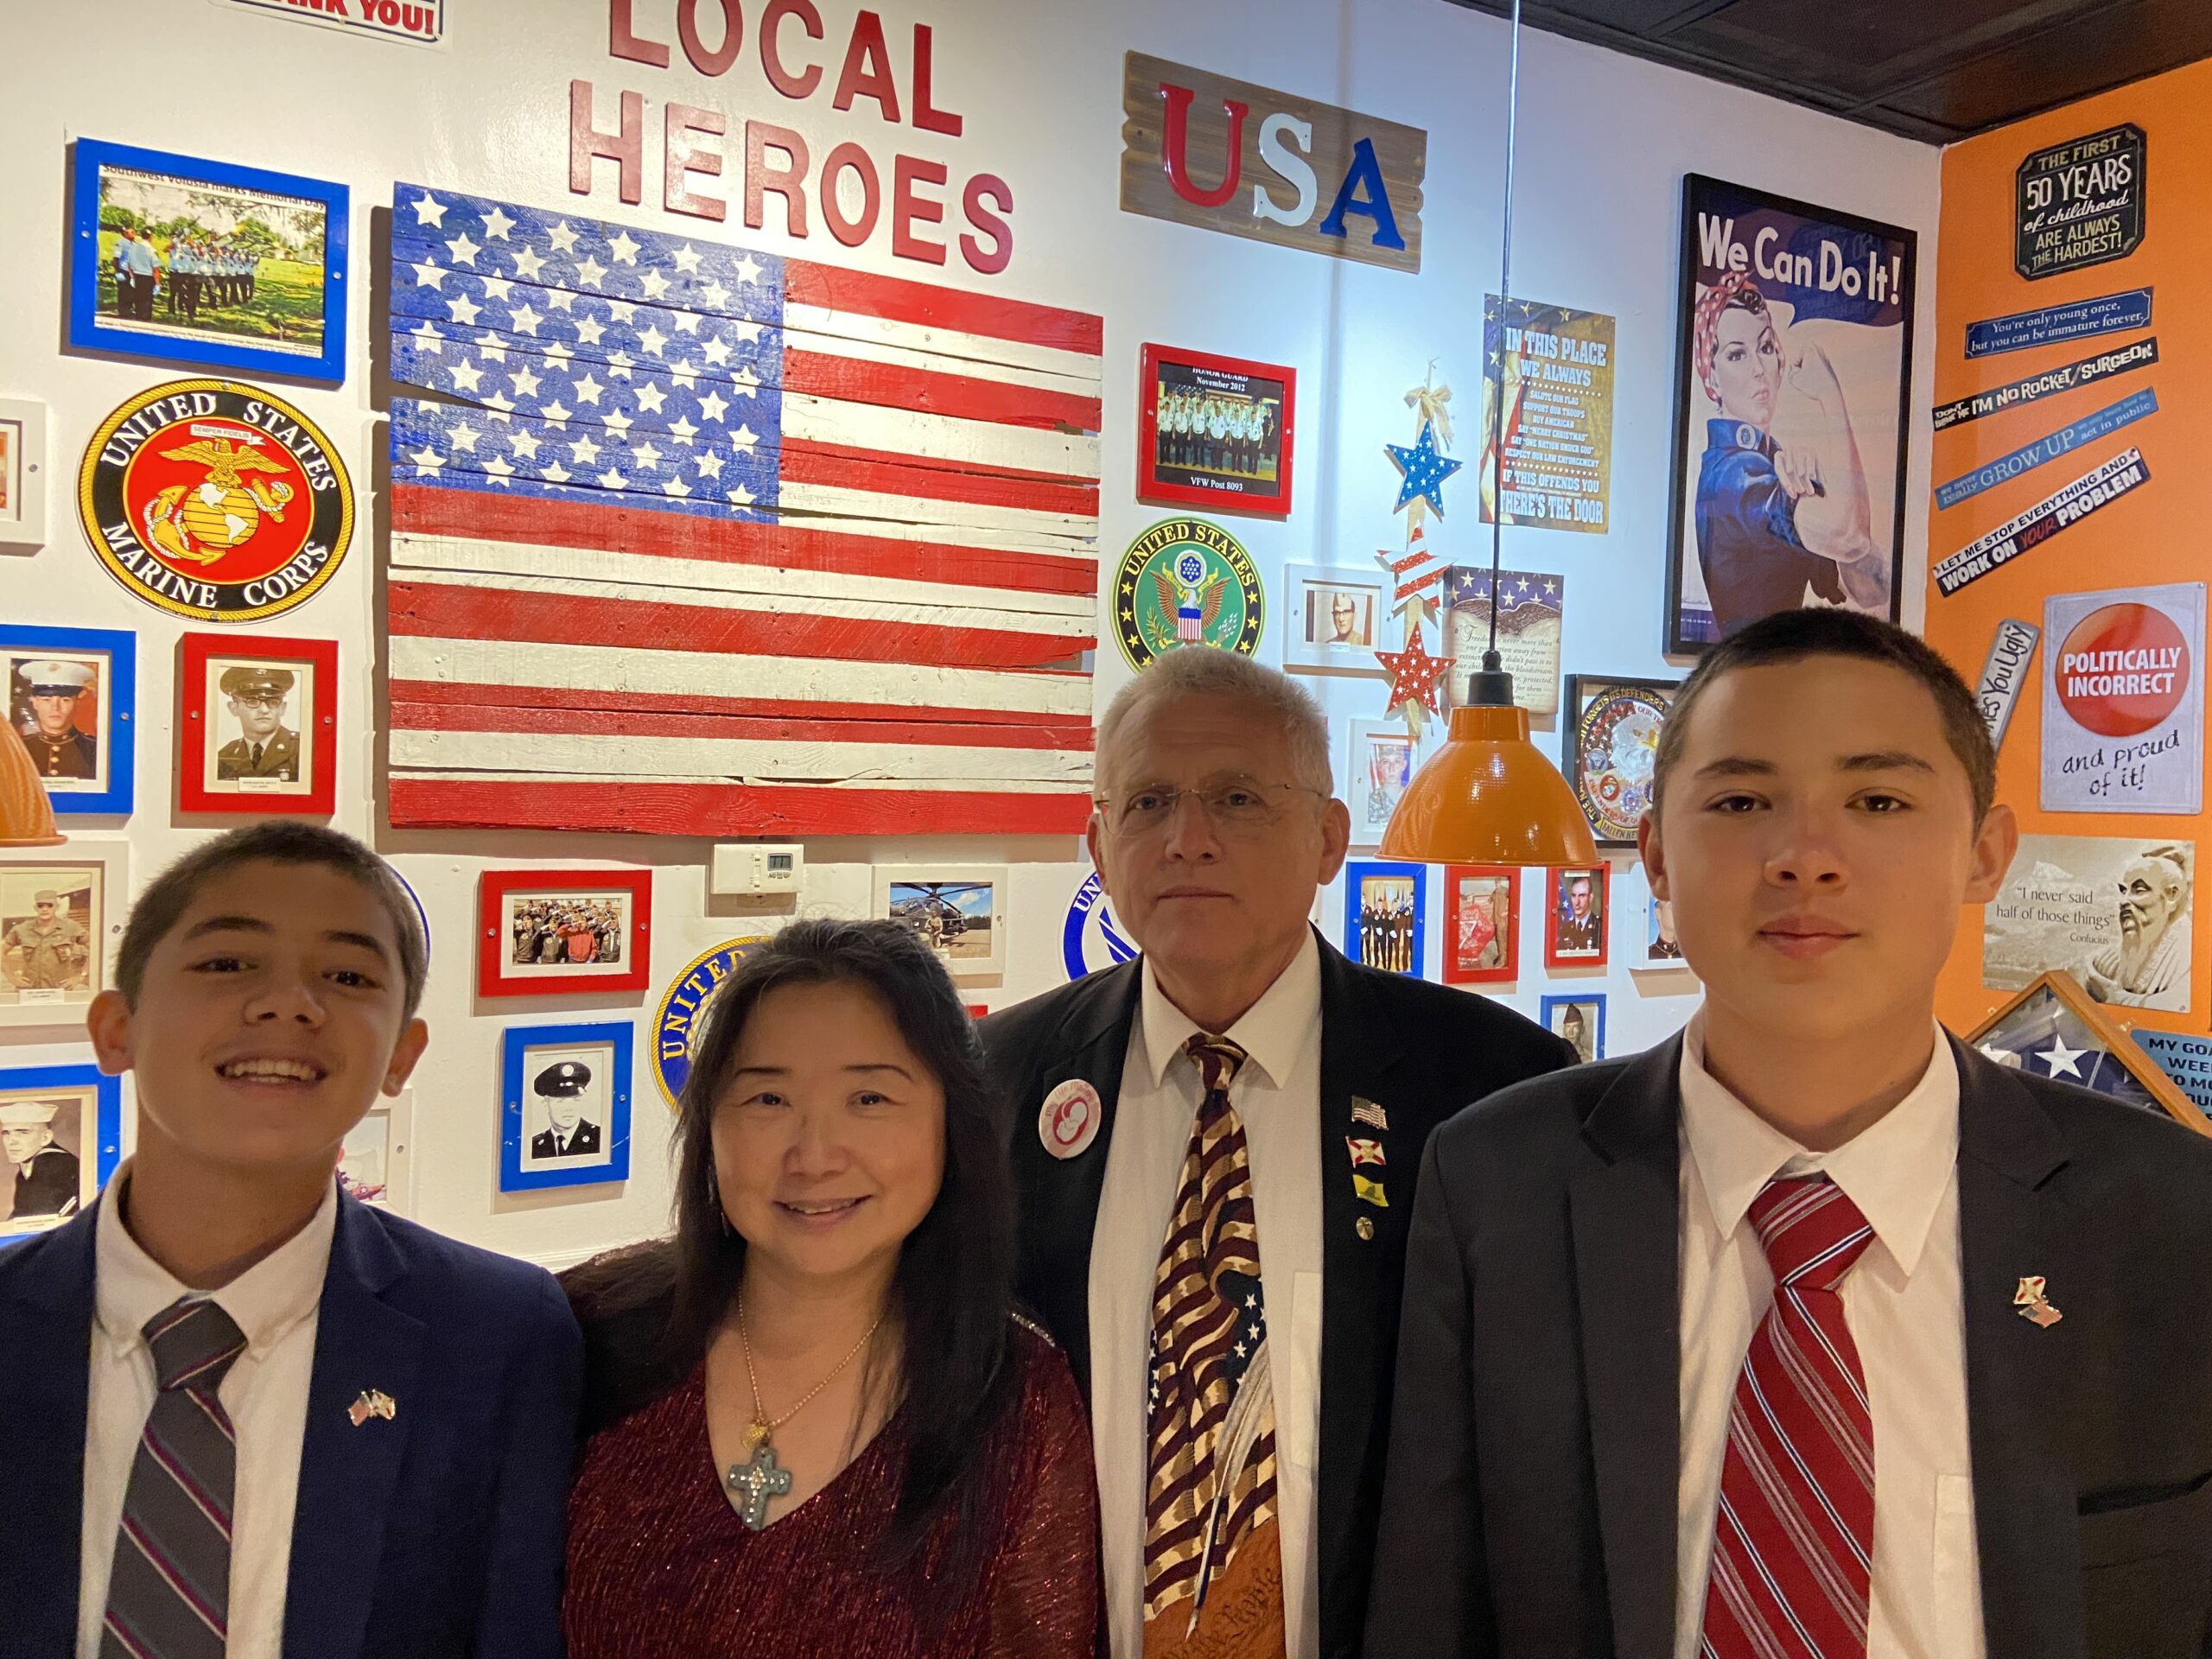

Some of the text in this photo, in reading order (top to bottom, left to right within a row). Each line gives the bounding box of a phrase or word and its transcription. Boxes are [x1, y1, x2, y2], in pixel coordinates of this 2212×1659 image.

[360, 0, 435, 35] YOU!
[609, 0, 963, 137] LOCAL
[1159, 82, 1405, 251] USA
[2038, 136, 2120, 170] THE FIRST
[569, 79, 1014, 275] HEROES
[2027, 154, 2132, 210] 50 YEARS
[2024, 189, 2129, 232] of childhood
[2032, 232, 2122, 269] THE HARDEST!
[2036, 214, 2120, 251] ARE ALWAYS
[1698, 213, 1901, 305] We Can Do It!
[1971, 310, 2144, 353] but you can be immature forever.
[1992, 302, 2121, 334] You're only young once,
[1506, 327, 1607, 366] IN THIS PLACE
[1196, 377, 1246, 391] November 2012
[1520, 359, 1592, 387] WE ALWAYS
[1972, 343, 2152, 415] I'M NO ROCKET SURGEON
[1523, 401, 1549, 413] SUPPORT
[2081, 403, 2150, 440] act in public
[100, 392, 337, 493] UNITED STATES
[1980, 428, 2075, 487] GROW UP
[1190, 476, 1243, 492] VFW Post 8093
[1503, 468, 1513, 482] IF
[1514, 470, 1536, 486] THIS
[1539, 474, 1580, 491] OFFENDS
[1581, 479, 1599, 493] YOU
[1500, 489, 1546, 518] THERE'S
[1548, 495, 1572, 520] THE
[1573, 498, 1604, 524] DOOR
[1941, 455, 2128, 572] LET ME STOP EVERYTHING AND
[1942, 465, 2142, 592] WORK ON YOUR PROBLEM
[102, 522, 328, 609] MARINE CORPS
[1125, 524, 1255, 587] UNITED STATES
[1981, 625, 2032, 695] You Ugly
[2063, 647, 2182, 674] POLITICALLY
[2068, 672, 2176, 697] INCORRECT
[2063, 729, 2180, 773] and proud
[2089, 764, 2145, 797] of it!
[2017, 887, 2093, 905] “I never said
[1996, 905, 2115, 931] half of those things”
[2069, 932, 2109, 945] Confucius
[2149, 1038, 2177, 1051] MY
[2168, 1057, 2212, 1073] WEE
